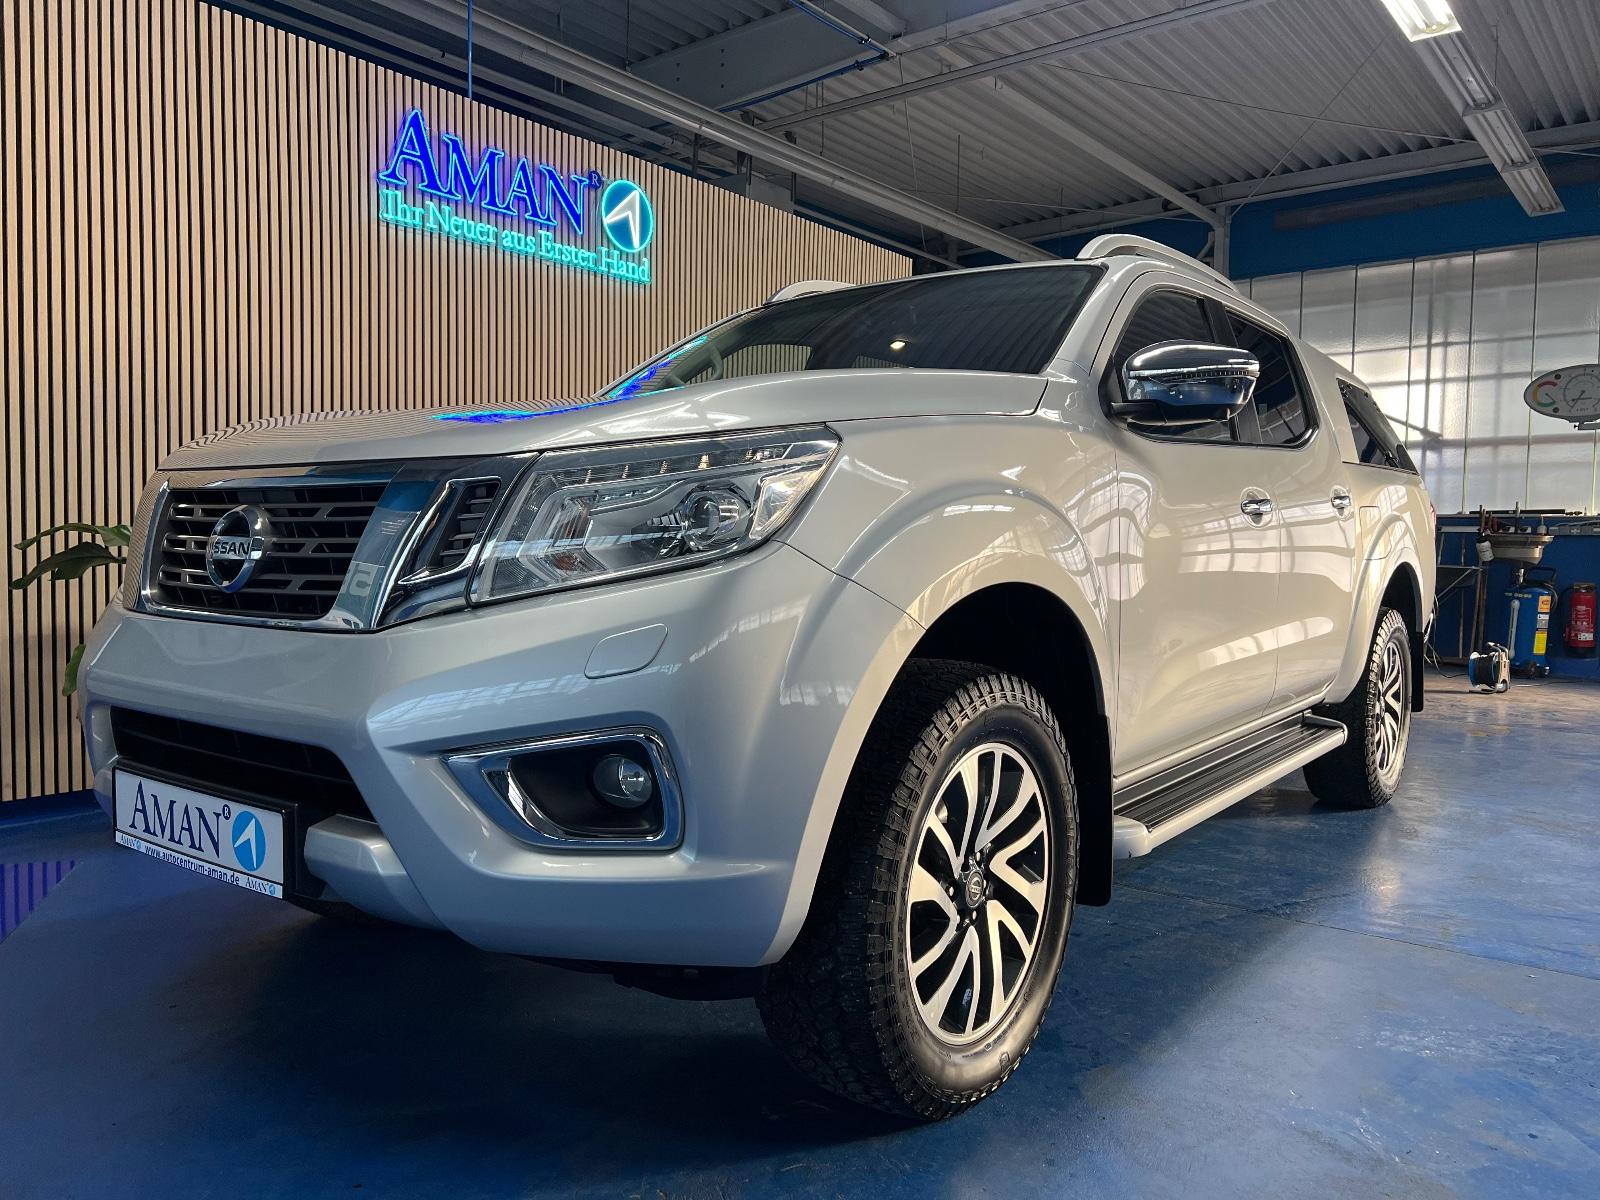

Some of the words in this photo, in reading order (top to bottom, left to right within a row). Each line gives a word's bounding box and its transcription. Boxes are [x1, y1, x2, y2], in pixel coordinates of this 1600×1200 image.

[380, 188, 425, 226] Ihr
[426, 200, 497, 245] Neuer
[501, 229, 536, 253] aus
[538, 230, 597, 268] Erster
[598, 246, 650, 283] Hand
[209, 541, 250, 556] SSAN
[144, 845, 240, 885] www.autocentrum-aman.de
